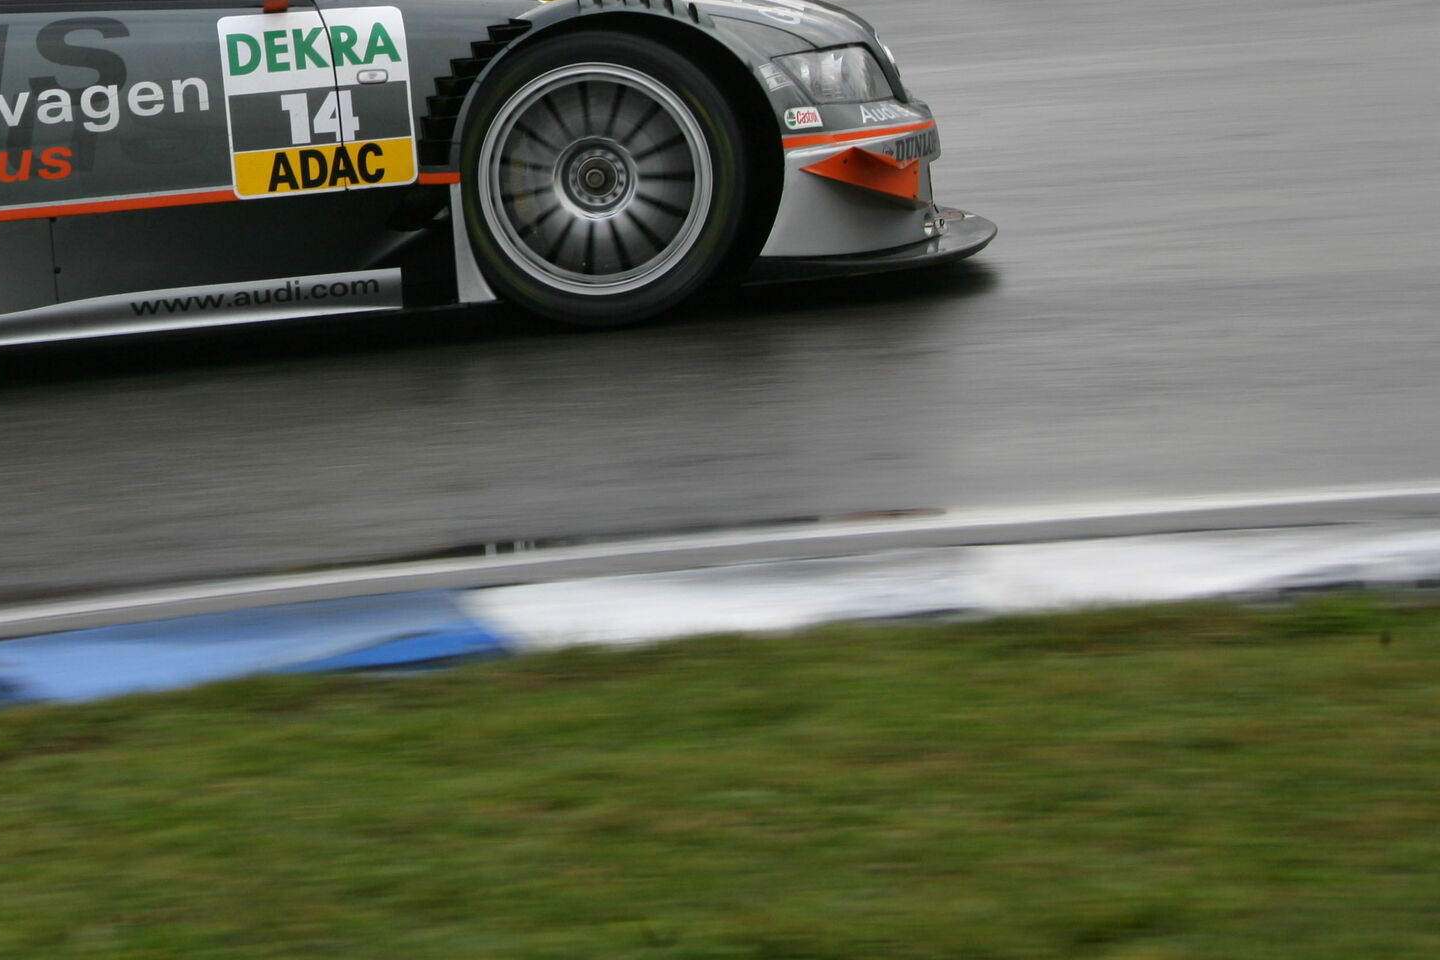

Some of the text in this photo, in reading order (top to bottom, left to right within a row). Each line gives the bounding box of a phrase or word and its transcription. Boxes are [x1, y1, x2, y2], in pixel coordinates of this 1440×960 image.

[226, 22, 401, 76] DEKRA
[280, 90, 361, 144] 14
[796, 111, 819, 124] Castrol
[268, 143, 386, 192] ADAC
[130, 278, 380, 316] www.audi.com
